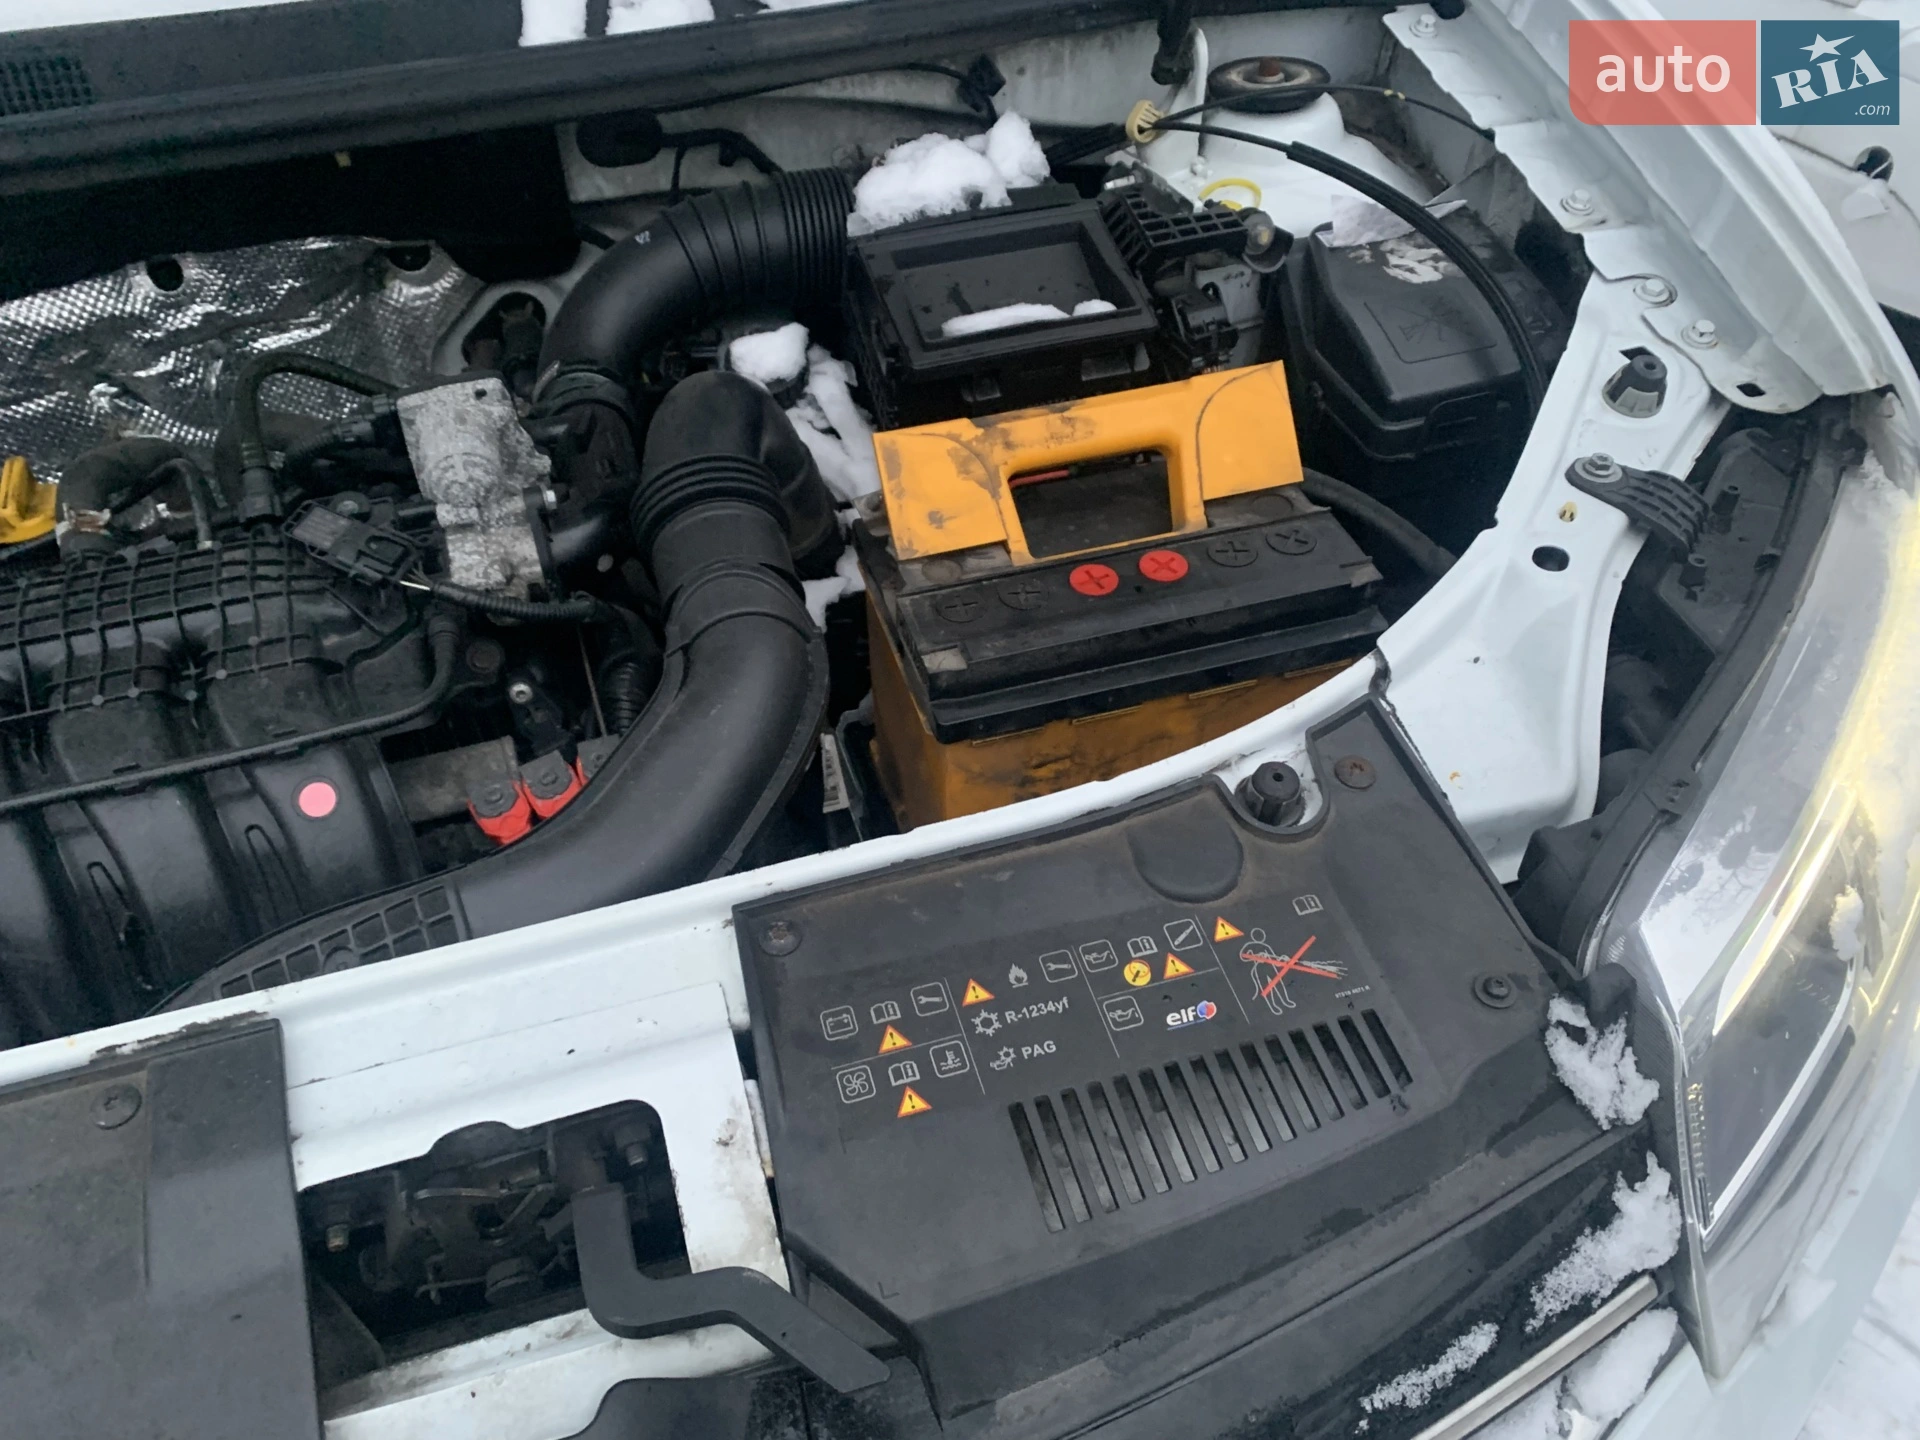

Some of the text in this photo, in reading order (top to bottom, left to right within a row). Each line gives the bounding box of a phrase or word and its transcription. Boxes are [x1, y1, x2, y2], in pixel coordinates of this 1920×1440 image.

[1004, 996, 1070, 1024] R-1234yf
[1166, 1005, 1197, 1026] elf
[1021, 1040, 1057, 1060] PAG
